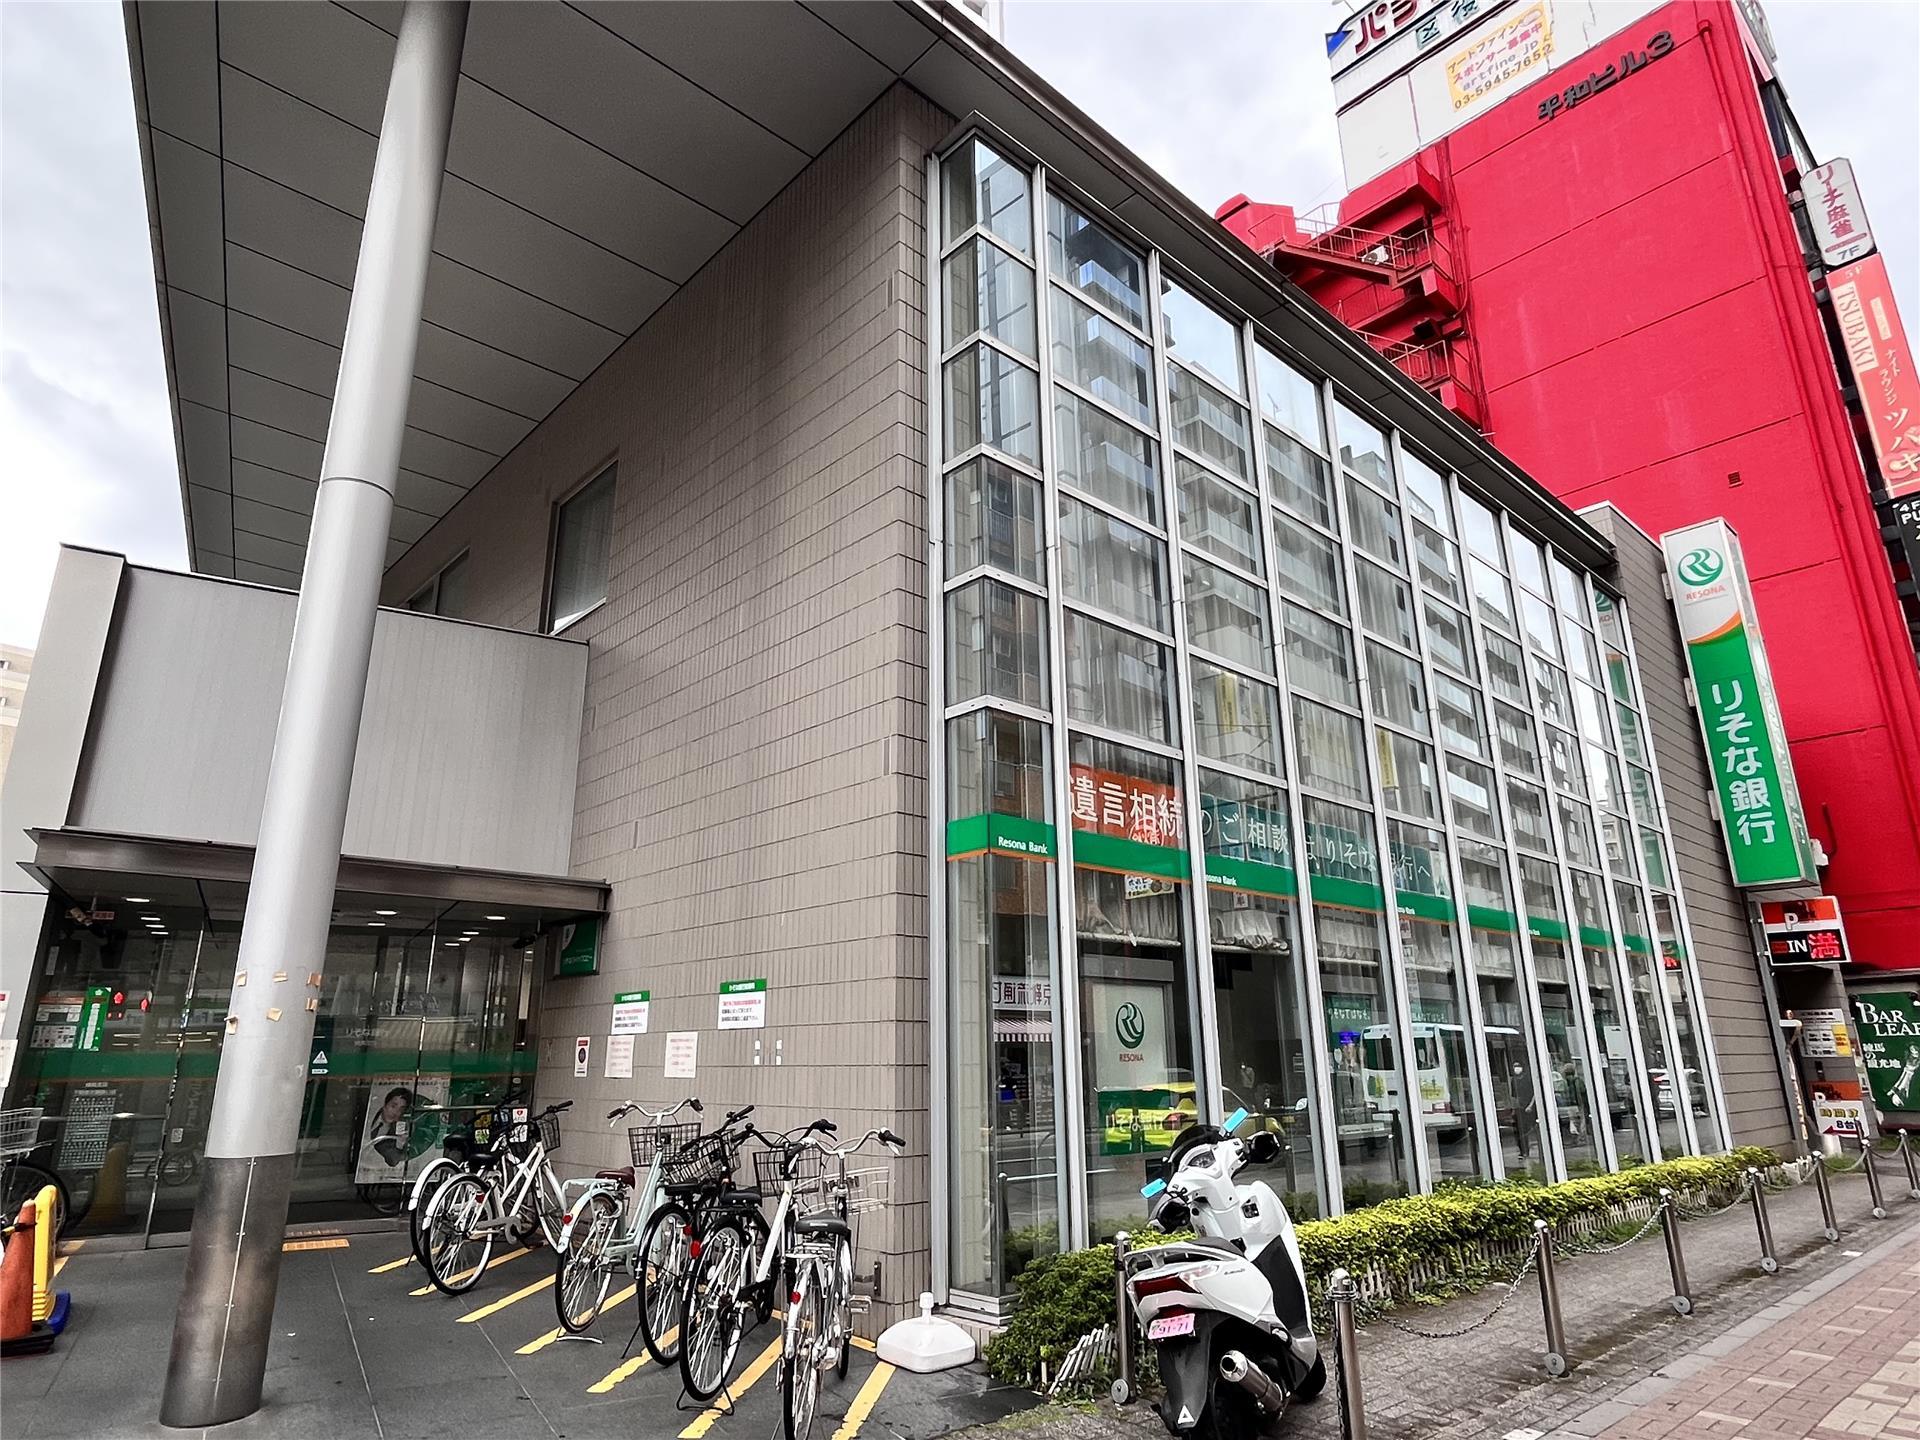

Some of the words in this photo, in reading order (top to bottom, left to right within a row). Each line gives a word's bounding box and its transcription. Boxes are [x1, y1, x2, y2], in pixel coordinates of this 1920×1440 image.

[1454, 44, 1554, 110] 03-5945-7652
[1538, 31, 1675, 120] 平和ビル3
[1815, 164, 1854, 239] リーチ麻雀
[1838, 245, 1860, 262] 7F
[1837, 286, 1876, 368] TSUBAKI
[1686, 585, 1727, 600] RESONA
[1711, 680, 1777, 846] りそな銀行
[1069, 775, 1183, 840] 遺言相続
[998, 836, 1026, 850] Resona
[1028, 841, 1048, 854] Bank
[1223, 876, 1238, 886] Bank
[1784, 912, 1798, 932] P
[1786, 940, 1808, 953] IN
[1808, 933, 1840, 959] 満
[1859, 1002, 1907, 1024] BAR
[1119, 1053, 1144, 1062] RESONA
